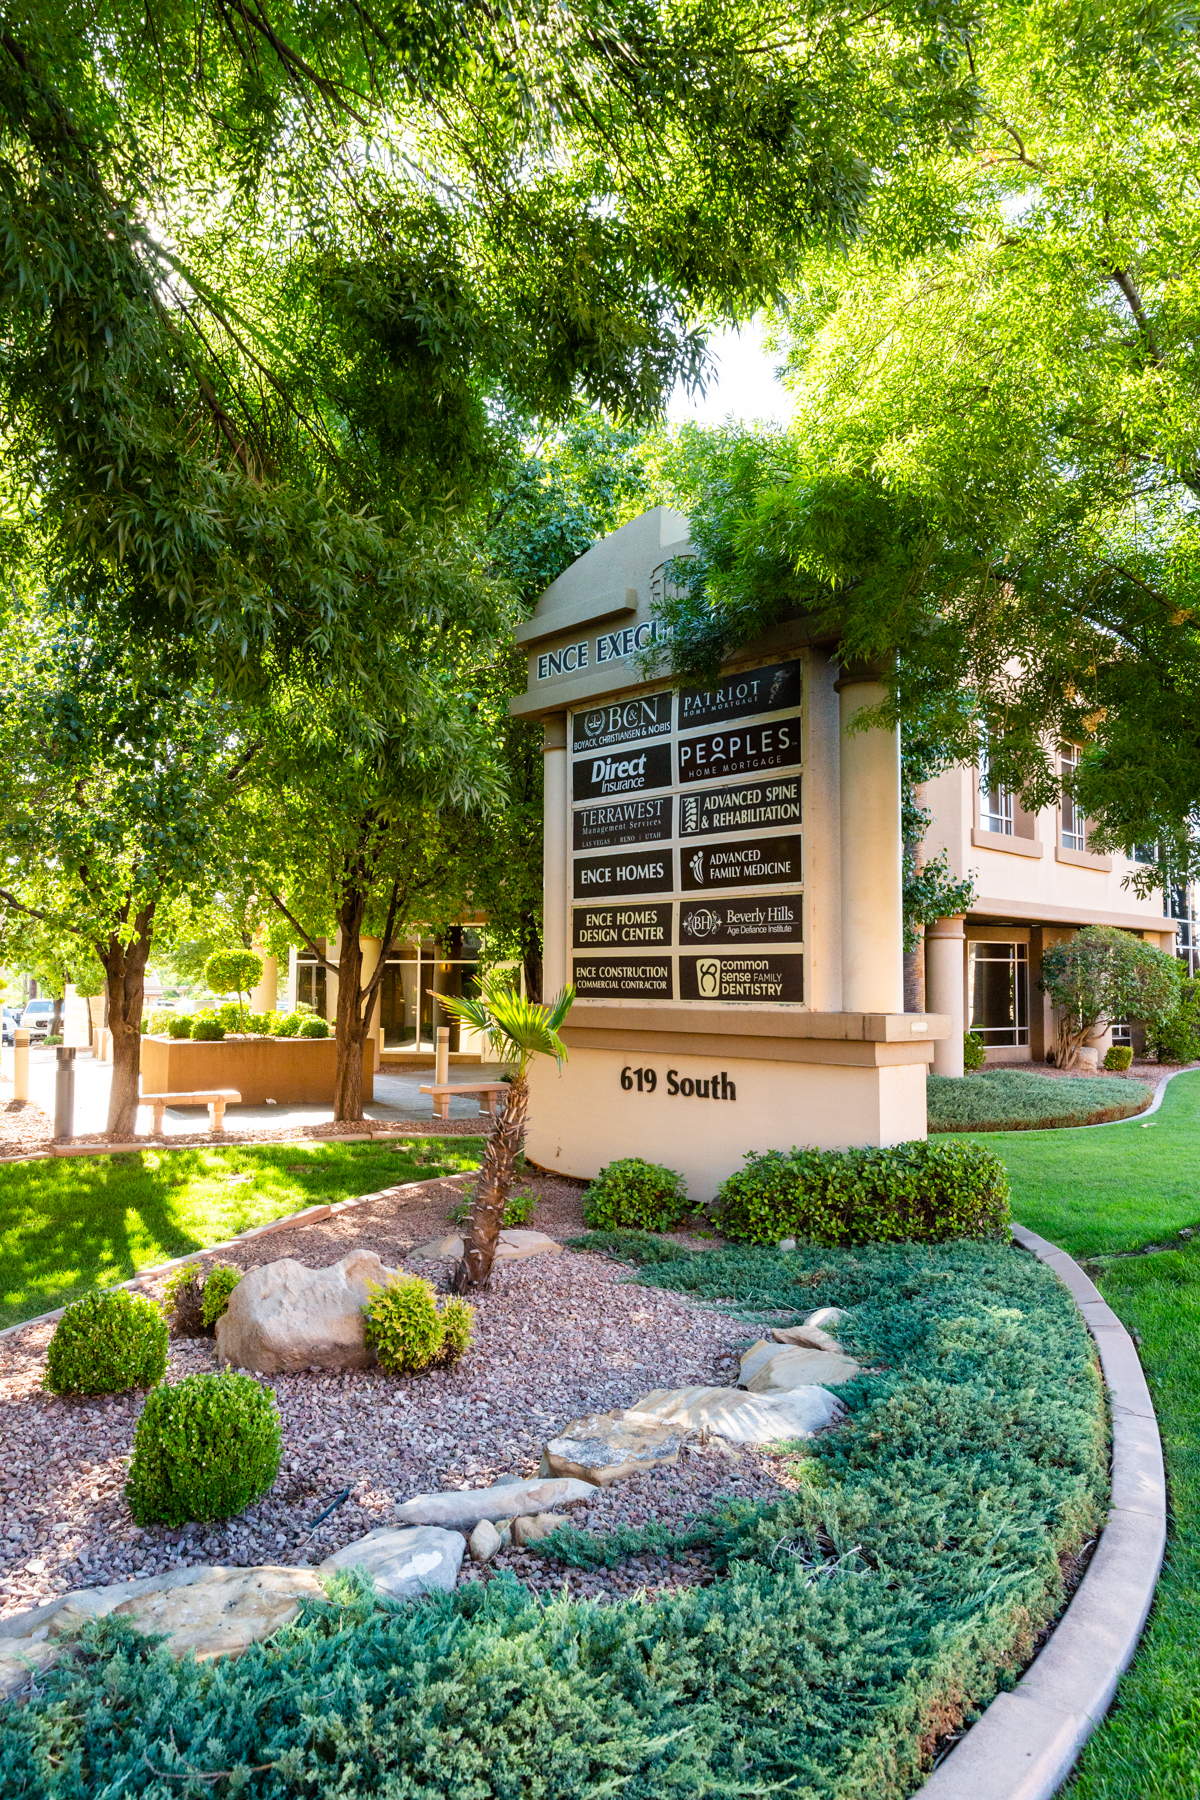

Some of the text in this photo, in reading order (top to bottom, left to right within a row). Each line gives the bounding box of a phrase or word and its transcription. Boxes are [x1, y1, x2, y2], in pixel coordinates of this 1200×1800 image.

[537, 641, 589, 681] ENCE
[684, 680, 761, 711] PATRIOT
[683, 696, 758, 718] HOME MORTGAGE
[573, 721, 671, 751] BOYACK, CHRISTIANSEN & NOBIS
[681, 727, 790, 767] PEOPLES
[591, 753, 647, 783] Direct
[688, 755, 782, 778] HOME MORTGAGE
[601, 776, 645, 793] Insurance
[703, 783, 798, 811] ADVANCED SPINE
[581, 800, 664, 827] TERRAWEST
[701, 802, 800, 829] & REHABILITATION
[582, 818, 662, 836] Management Services
[593, 838, 611, 846] VEGAS
[619, 835, 636, 843] RENO
[644, 831, 661, 840] UTAH
[710, 849, 761, 865] ADVANCED
[581, 862, 664, 884] ENCE HOMES
[710, 861, 791, 880] FAMILY MEDICINE
[586, 910, 658, 926] ENCE HOMES
[694, 916, 710, 930] BH
[726, 906, 794, 926] Beverly Hills
[579, 926, 664, 942] DESIGN CENTER
[726, 924, 792, 936] Age Defiance Institute
[576, 966, 668, 978] ENCE CONSTRUCTION
[721, 960, 769, 970] common
[577, 980, 667, 990] COMMERCIAL CONTRACTOR
[721, 971, 782, 982] sense FAMILY
[721, 983, 783, 996] DENTISTRY
[620, 1066, 736, 1101] 619 South
